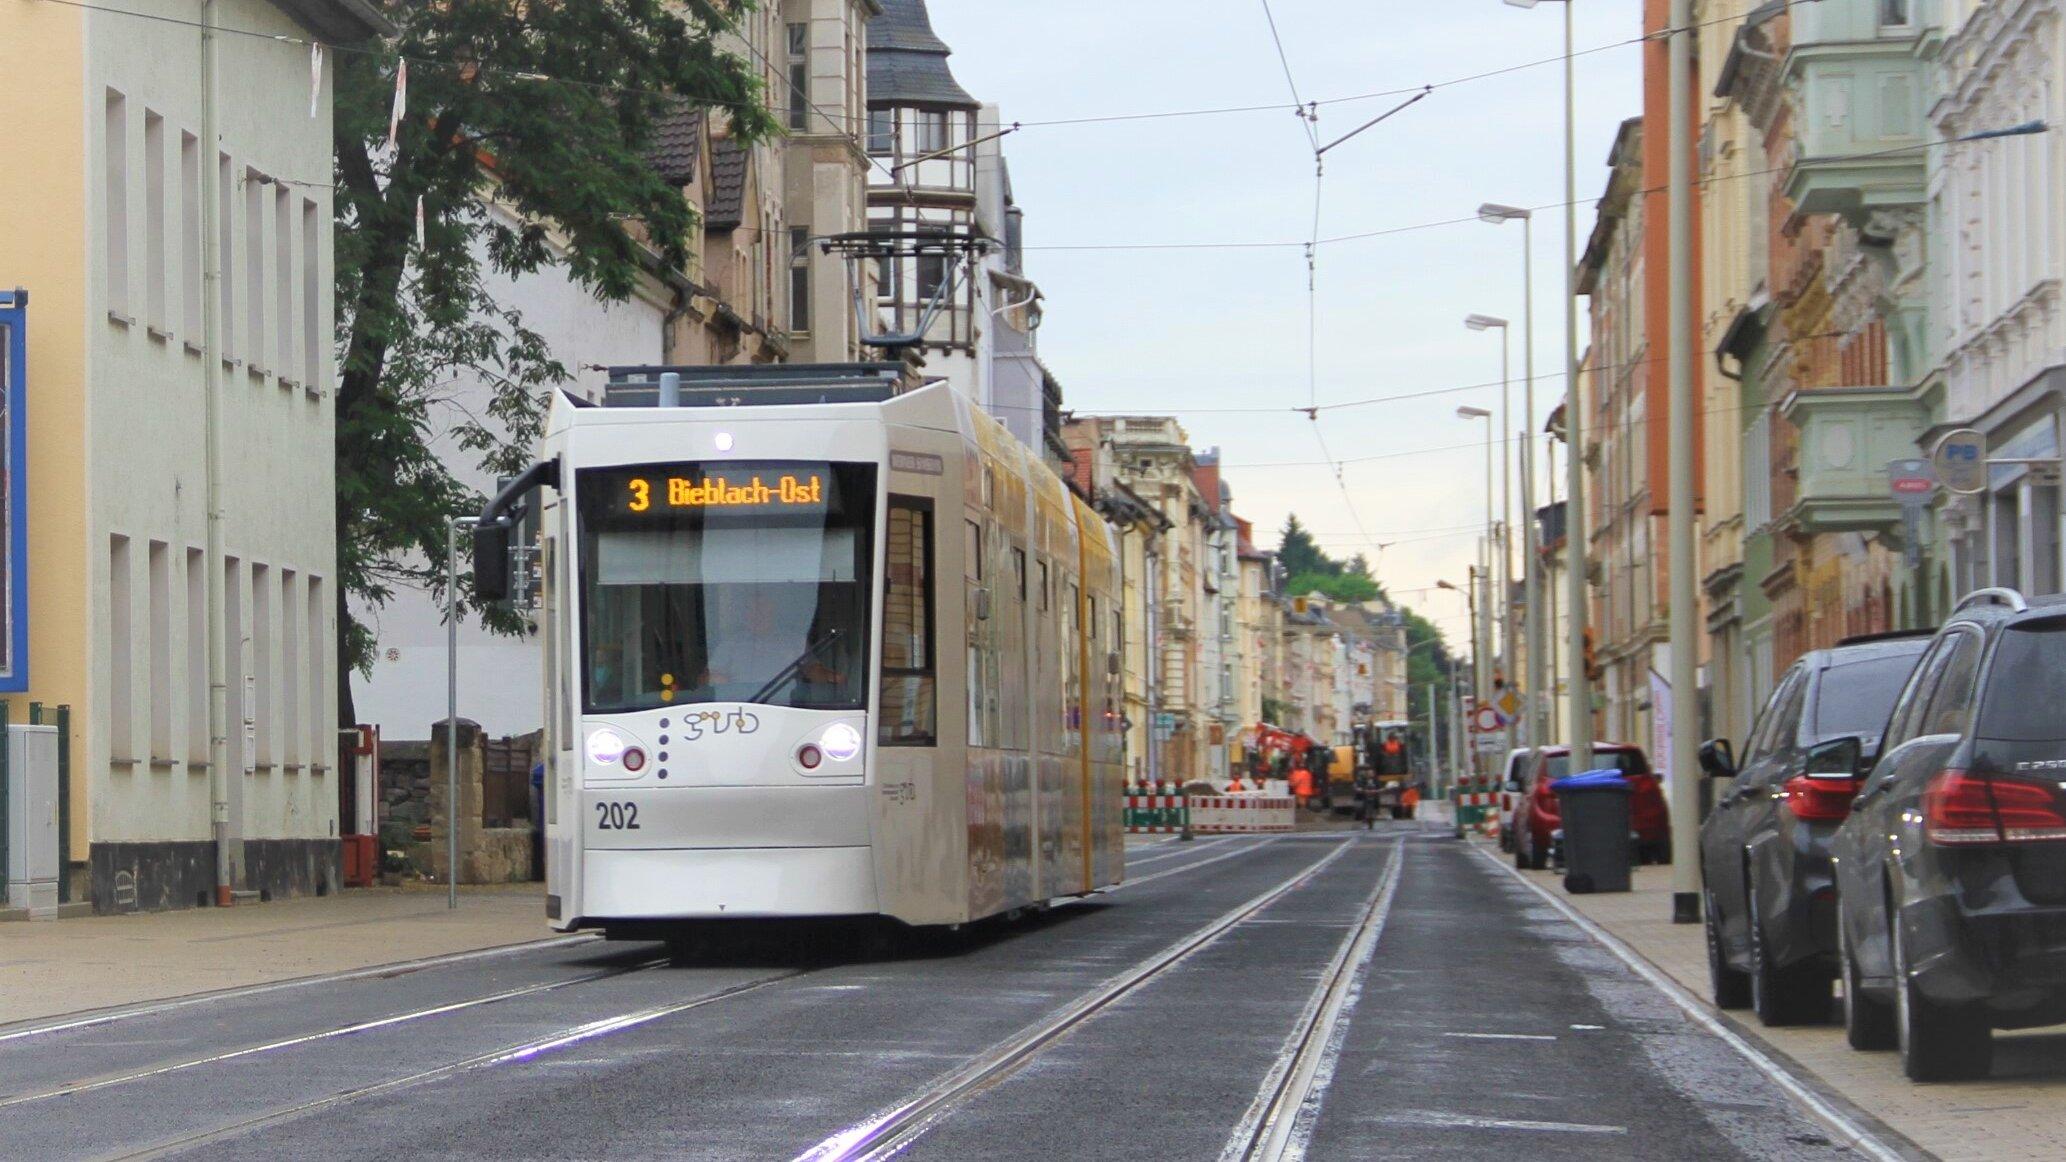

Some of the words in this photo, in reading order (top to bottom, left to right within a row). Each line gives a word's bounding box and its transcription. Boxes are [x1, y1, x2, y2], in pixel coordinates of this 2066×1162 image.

[628, 478, 650, 512] 3
[667, 475, 821, 506] Bieblach-Ost
[596, 801, 640, 830] 202
